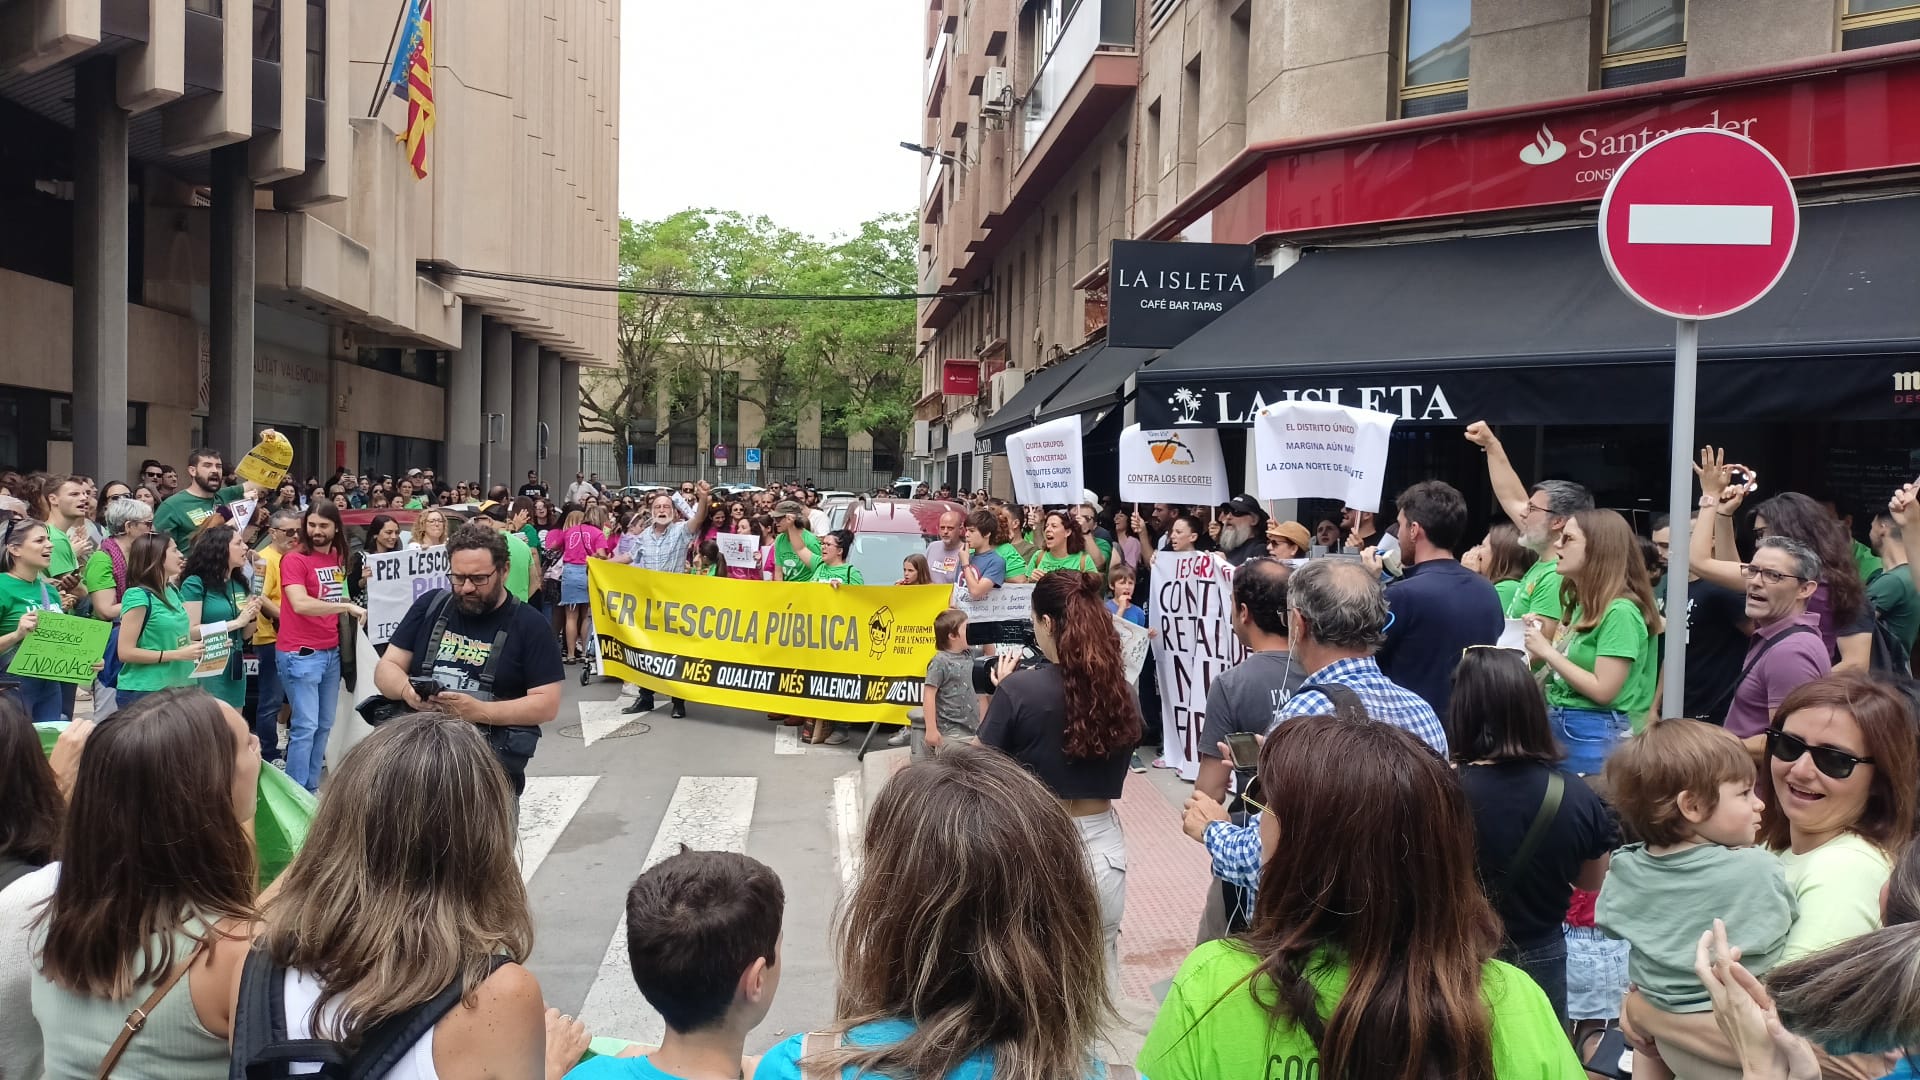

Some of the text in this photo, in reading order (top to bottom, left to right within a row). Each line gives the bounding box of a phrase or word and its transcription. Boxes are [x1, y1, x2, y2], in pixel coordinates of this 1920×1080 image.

[1120, 269, 1245, 292] LA ISLETA
[1140, 299, 1222, 311] CAFÉ BAR TAPAS
[1297, 424, 1331, 432] DISTRITO
[1333, 422, 1355, 434] ÚNICO
[1026, 440, 1064, 449] QUITA GRUPOS
[1286, 442, 1324, 451] MARGINA
[1326, 441, 1343, 451] AÚN
[1033, 454, 1067, 462] CONCERTADA
[1032, 468, 1051, 477] QUITES
[1052, 467, 1071, 475] GRUPOS
[1266, 463, 1277, 471] LA
[1280, 462, 1304, 470] ZONA
[1305, 462, 1331, 471] NORTE
[1333, 463, 1343, 472] DE
[1127, 474, 1159, 482] CONTRA
[376, 550, 450, 581] PER L'ESCO
[1176, 557, 1192, 579] IES
[644, 598, 759, 644] L'ESCOLA
[765, 603, 859, 652] PÚBLICA
[894, 636, 907, 644] PER
[601, 638, 623, 661] MÉS
[624, 647, 677, 677] INVERSIÓ
[681, 659, 713, 683] MÉS
[716, 666, 775, 691] QUALITAT
[778, 669, 804, 694] MÉS
[810, 673, 861, 700] VALENCIÀ
[865, 677, 889, 701] MÉS
